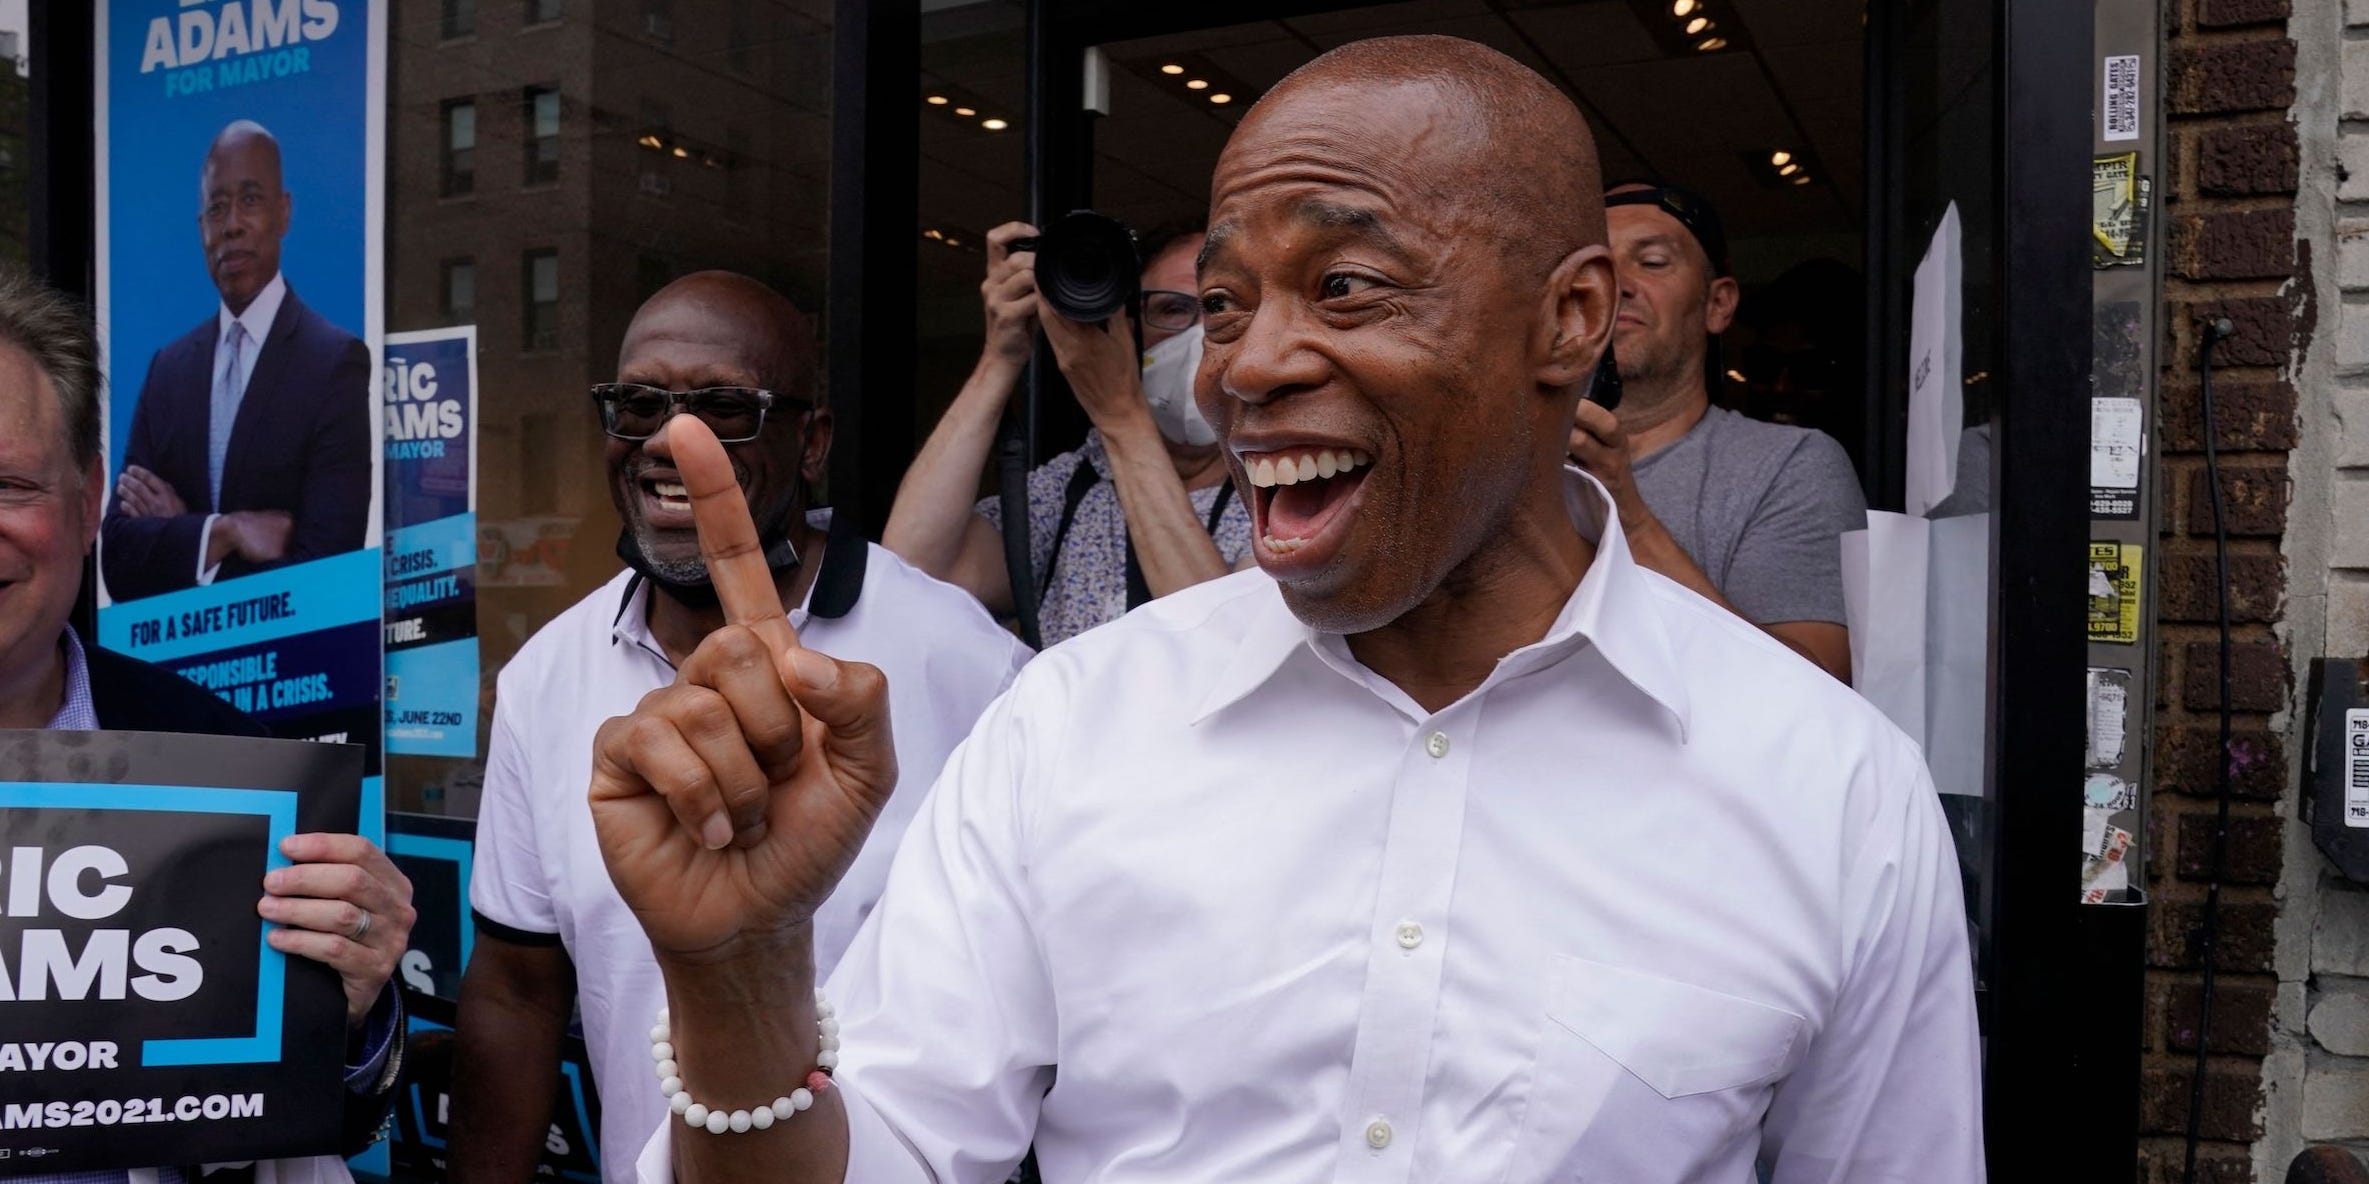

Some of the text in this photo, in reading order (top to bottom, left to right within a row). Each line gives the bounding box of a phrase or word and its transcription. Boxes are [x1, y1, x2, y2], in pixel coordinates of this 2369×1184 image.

[140, 0, 339, 74] ADAMS
[166, 46, 310, 98] FOR MAYOR
[2108, 62, 2118, 130] ROLLING GATES
[391, 549, 438, 576] CRISIS.
[130, 591, 296, 648] FOR A SAFE FUTURE.
[384, 617, 427, 644] TURE.
[234, 686, 253, 713] IN
[256, 684, 268, 712] A
[272, 672, 333, 708] CRISIS.
[399, 709, 430, 725] JUNE
[431, 711, 463, 726] 22ND
[0, 845, 134, 920] IC
[0, 1041, 119, 1072] AYOR
